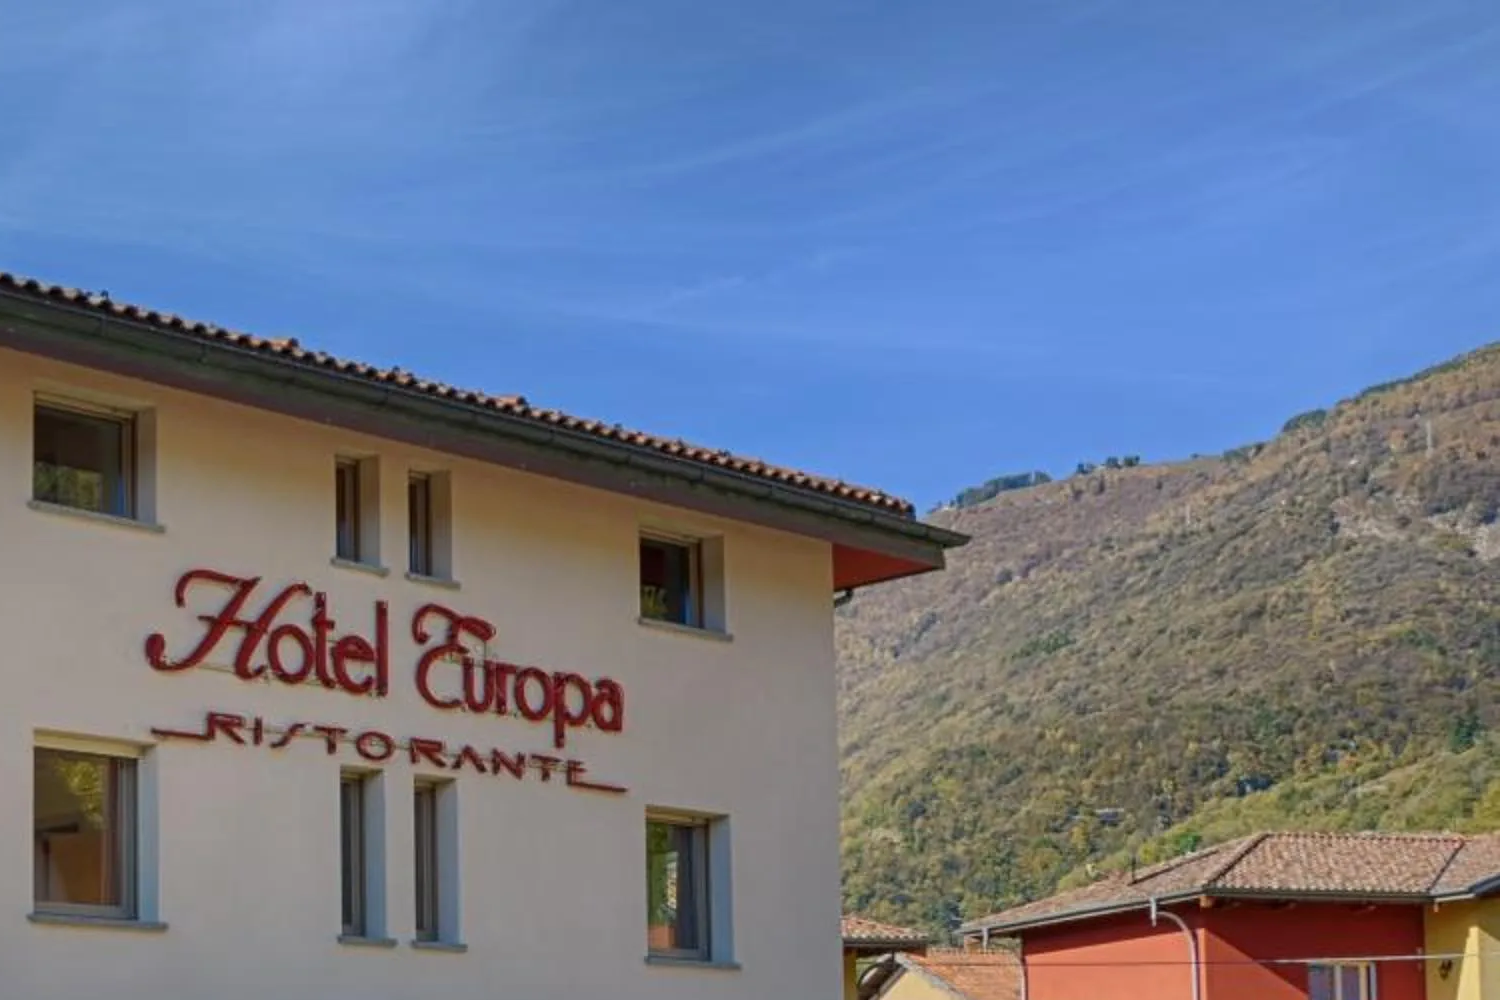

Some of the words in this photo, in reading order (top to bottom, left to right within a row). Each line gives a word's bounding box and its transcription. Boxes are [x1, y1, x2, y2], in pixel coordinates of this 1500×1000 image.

[145, 569, 389, 698] Hotel
[411, 603, 625, 749] Europa
[150, 711, 628, 794] RISTORANTE
